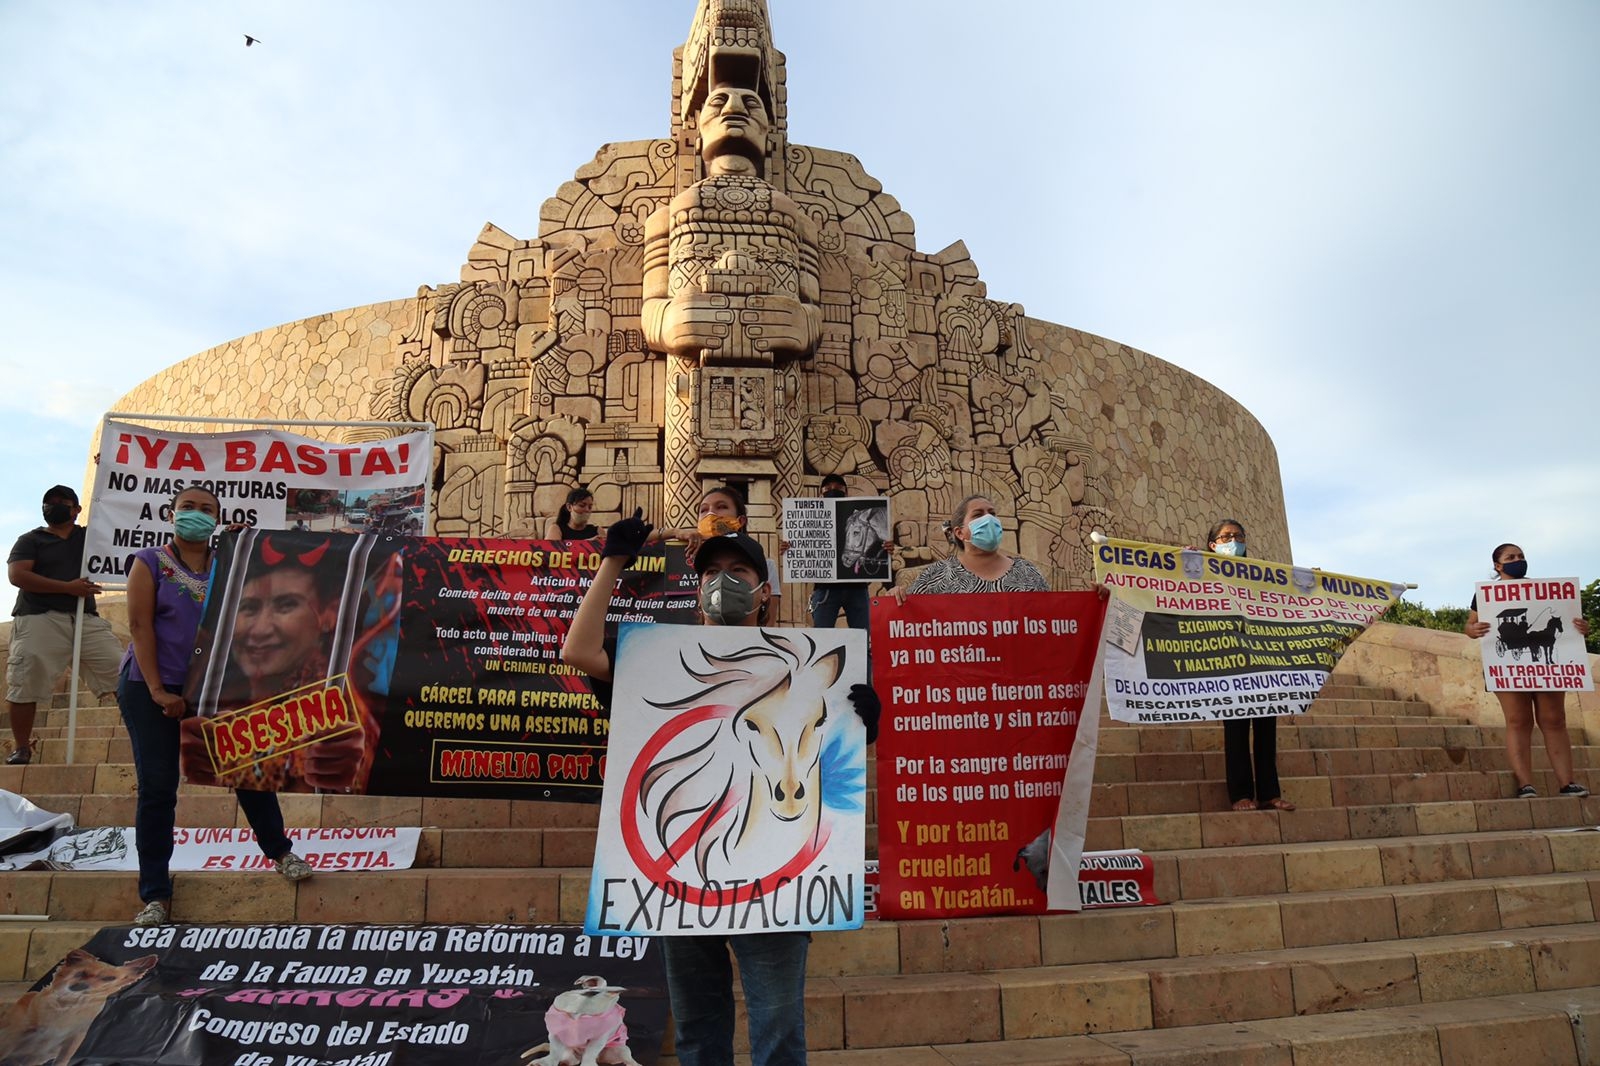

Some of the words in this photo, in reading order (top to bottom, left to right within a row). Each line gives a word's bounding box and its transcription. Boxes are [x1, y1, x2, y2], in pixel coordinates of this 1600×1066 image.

[116, 433, 206, 472] ¡YA
[224, 441, 409, 476] BASTA!
[108, 472, 138, 492] NO
[143, 477, 185, 495] MAS
[139, 502, 153, 520] A
[787, 511, 804, 519] EVITA
[805, 510, 831, 519] UTILIZAR
[794, 500, 824, 509] TURISTA
[785, 520, 798, 529] LOS
[798, 520, 833, 529] CARRUAJES
[788, 531, 793, 539] O
[112, 525, 174, 548] MÉRID
[788, 540, 796, 549] NO
[798, 540, 832, 549] PARTICIPES
[448, 549, 543, 567] DERECHOS
[548, 551, 573, 568] DE
[578, 553, 601, 570] LO
[787, 550, 795, 559] EN
[796, 550, 804, 559] EL
[805, 550, 836, 559] MALTRATO
[787, 560, 792, 568] Y
[792, 558, 833, 569] EXPLOTACIÓN
[531, 575, 576, 587] Artículo
[791, 570, 799, 579] DE
[800, 570, 833, 579] CABALLOS.
[1099, 545, 1176, 571] CIEGAS
[1207, 558, 1288, 586] SORDAS
[1321, 576, 1390, 601] MUDAS
[438, 587, 479, 600] Comete
[481, 589, 511, 601] delito
[513, 591, 527, 602] de
[529, 592, 574, 604] maltrato
[634, 598, 664, 610] quien
[666, 599, 696, 609] cause
[1104, 572, 1224, 594] AUTORIDADES
[1228, 585, 1256, 601] DEL
[1260, 591, 1324, 607] ESTADO
[1327, 597, 1349, 610] DE
[1480, 581, 1575, 602] TORTURA
[487, 605, 524, 616] muerte
[527, 606, 541, 617] de
[543, 609, 556, 618] un
[605, 612, 657, 624] oméstico.
[1156, 596, 1232, 611] HAMBRE
[1234, 600, 1242, 612] Y
[1246, 604, 1278, 617] SED
[1283, 609, 1307, 619] DE
[1311, 609, 1375, 625] JUSTICIA
[435, 627, 460, 639] Todo
[463, 629, 486, 640] acto
[489, 631, 509, 642] que
[512, 630, 558, 644] implique
[889, 618, 988, 639] Marchamos
[992, 620, 1019, 637] por
[1023, 616, 1047, 635] los
[1051, 618, 1078, 637] que
[1177, 620, 1234, 635] EXIGIMOS
[1235, 620, 1243, 631] Y
[1244, 623, 1320, 637] DEMANDAMOS
[474, 646, 539, 658] considerado
[542, 649, 555, 659] un
[1146, 639, 1154, 652] A
[1156, 634, 1239, 653] MODIFICACIÓN
[1240, 636, 1248, 647] A
[1250, 638, 1264, 650] LA
[1266, 639, 1285, 652] LEY
[890, 649, 909, 668] ya
[915, 648, 935, 664] no
[940, 644, 1001, 663] están...
[1173, 658, 1182, 672] Y
[1185, 654, 1246, 672] MALTRATO
[1250, 654, 1292, 667] ANIMAL
[1294, 653, 1316, 666] DEL
[485, 660, 500, 671] UN
[503, 660, 545, 674] CRIMEN
[1489, 665, 1503, 677] NI
[1507, 660, 1586, 677] TRADICIÓN
[1115, 679, 1130, 694] DE
[1133, 681, 1150, 696] LO
[1152, 679, 1230, 697] CONTRARIO
[1233, 673, 1314, 691] RENUNCIEN,
[1495, 677, 1510, 689] NI
[1513, 677, 1584, 689] CULTURA
[420, 682, 473, 705] CÁRCEL
[477, 688, 516, 706] PARA
[892, 686, 921, 705] Por
[926, 685, 951, 703] los
[956, 686, 987, 705] que
[992, 683, 1043, 701] fueron
[1126, 696, 1233, 710] RESCATISTAS
[404, 710, 485, 731] QUEREMOS
[489, 714, 520, 733] UNA
[525, 715, 588, 735] ASESINA
[893, 711, 989, 732] cruelmente
[994, 715, 1004, 731] y
[1008, 710, 1033, 728] sin
[1037, 707, 1077, 727] razón
[1138, 708, 1206, 723] MÉRIDA,
[1210, 704, 1294, 719] YUCATÁN,
[214, 686, 349, 765] ASESINA
[440, 749, 541, 779] MINELIA
[547, 754, 593, 780] PAT
[895, 756, 925, 775] Por
[929, 755, 945, 774] la
[950, 758, 1008, 775] sangre
[1013, 753, 1069, 771] derram
[896, 784, 917, 802] de
[922, 783, 948, 802] los
[953, 785, 984, 804] que
[989, 784, 1009, 800] no
[1014, 780, 1061, 799] tienen
[195, 828, 232, 845] UNA
[897, 821, 910, 844] Y
[916, 824, 951, 846] por
[956, 819, 1009, 843] tanta
[308, 851, 395, 869] BESTIA.
[898, 853, 991, 878] crueldad
[597, 864, 854, 932] EXPLOTACIÓN
[900, 890, 926, 910] en
[931, 884, 1034, 909] Yucatán...
[124, 927, 176, 948] sea
[180, 927, 311, 952] aprobada
[317, 927, 346, 951] la
[352, 928, 438, 952] nueva
[444, 929, 564, 955] Reforma
[574, 937, 590, 957] a
[599, 936, 650, 961] Ley
[199, 961, 240, 982] de
[242, 961, 273, 983] la
[277, 962, 368, 986] Fauna
[373, 967, 412, 986] en
[420, 963, 541, 987] Yucatán.
[188, 1009, 320, 1046] Congreso
[326, 1021, 374, 1047] del
[377, 1021, 470, 1045] Estado
